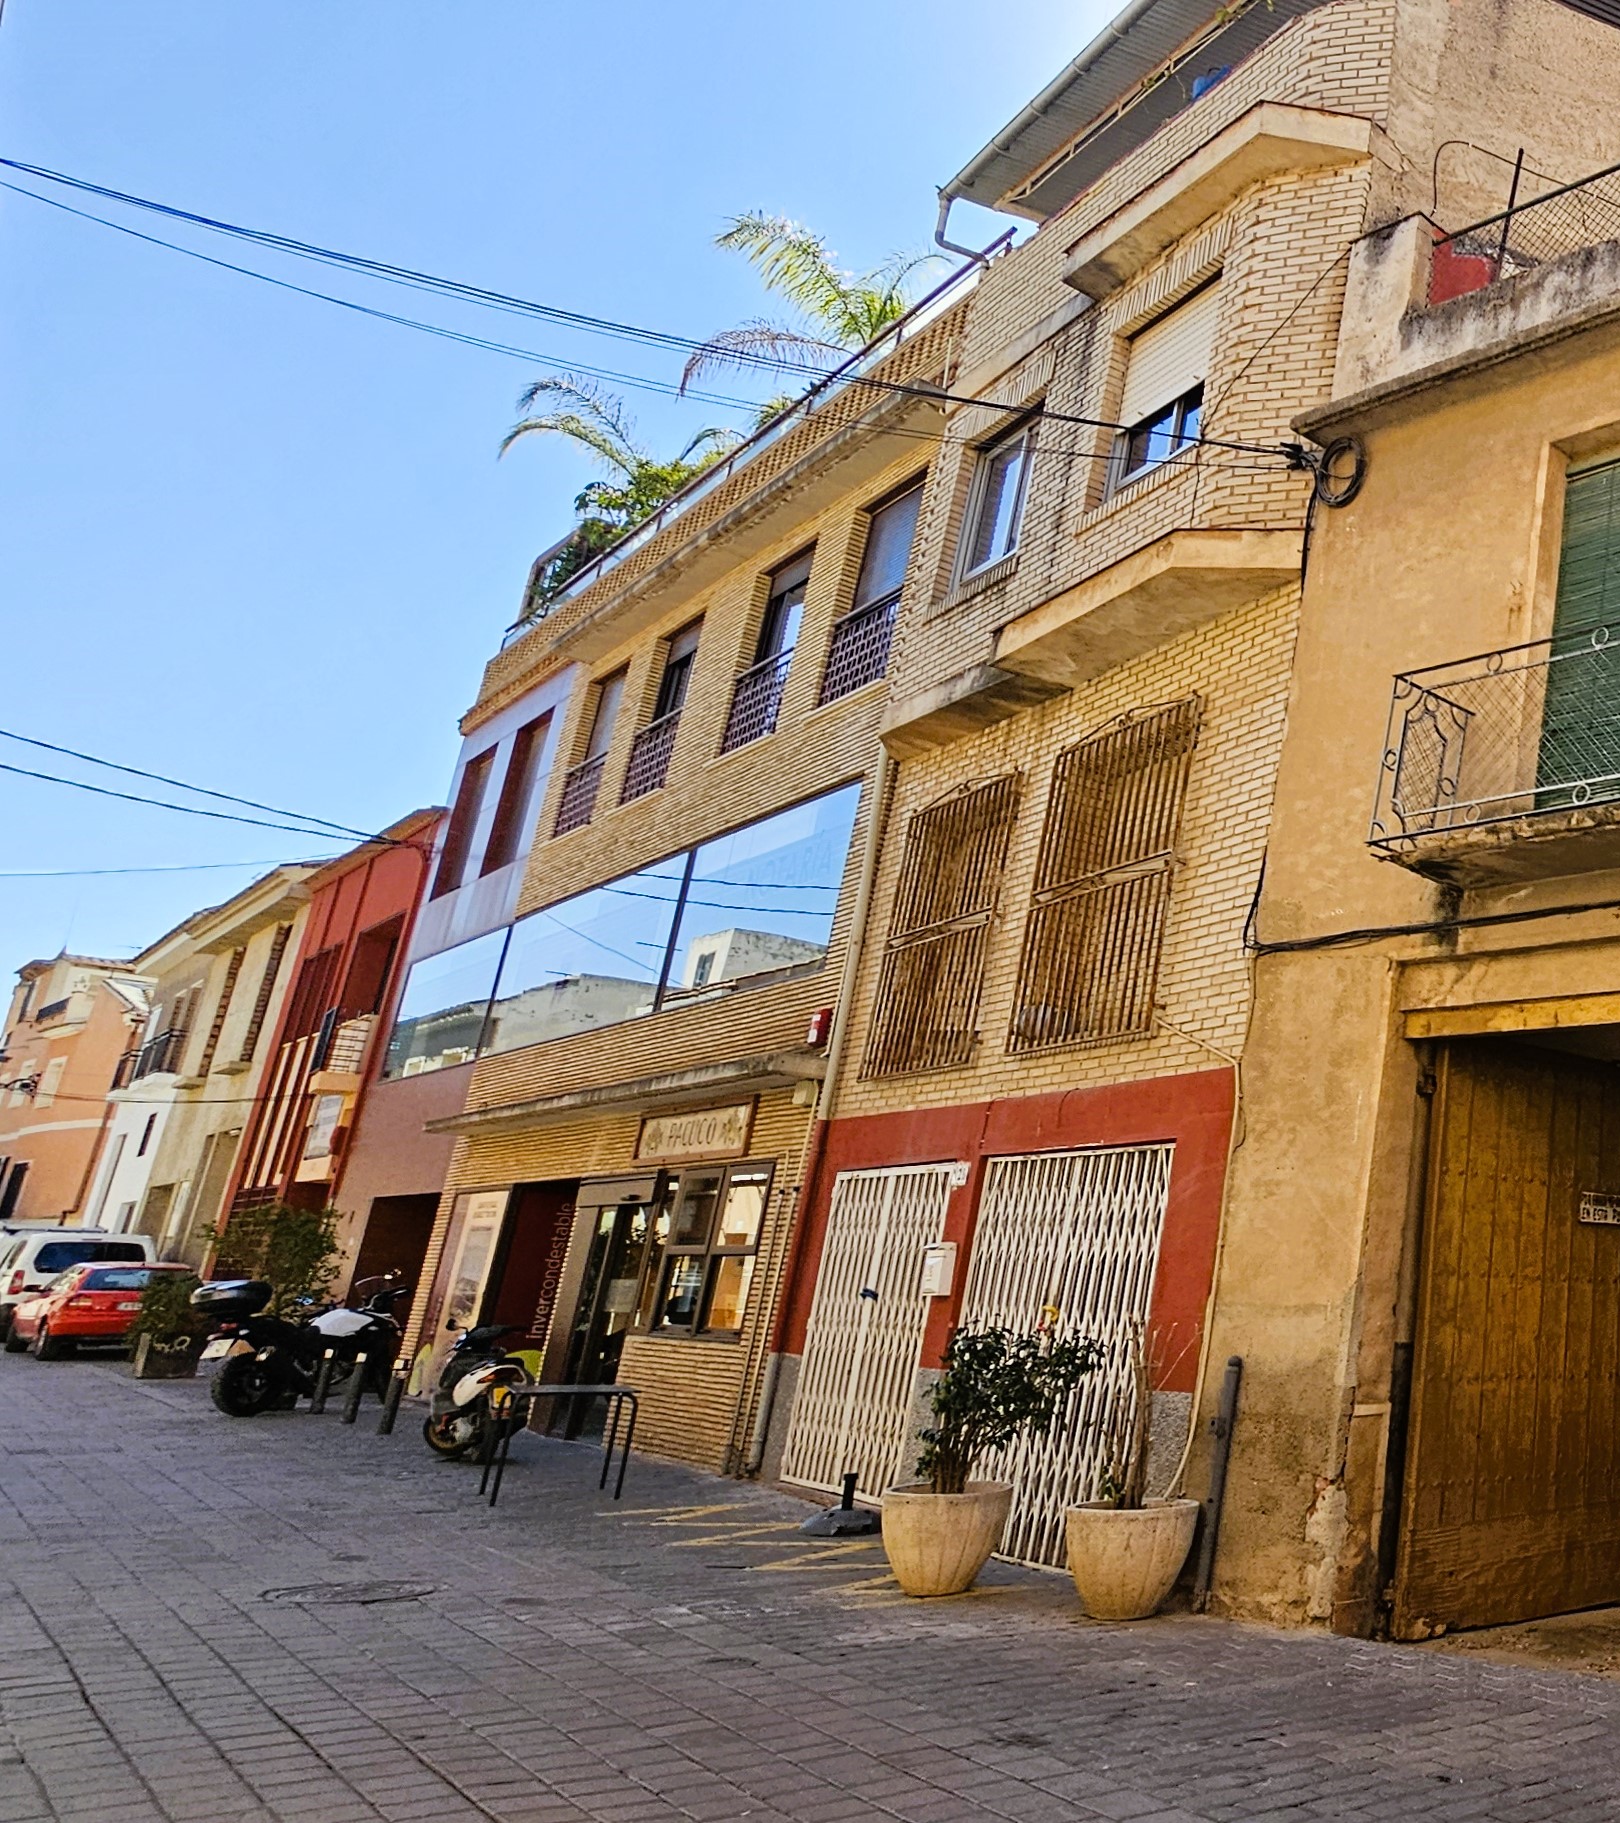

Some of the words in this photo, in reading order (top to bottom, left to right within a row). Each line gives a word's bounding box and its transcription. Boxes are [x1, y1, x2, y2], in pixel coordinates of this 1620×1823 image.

[744, 841, 834, 902] NOTARIA
[667, 1117, 718, 1147] PACUCO
[525, 1203, 575, 1339] invercondestable
